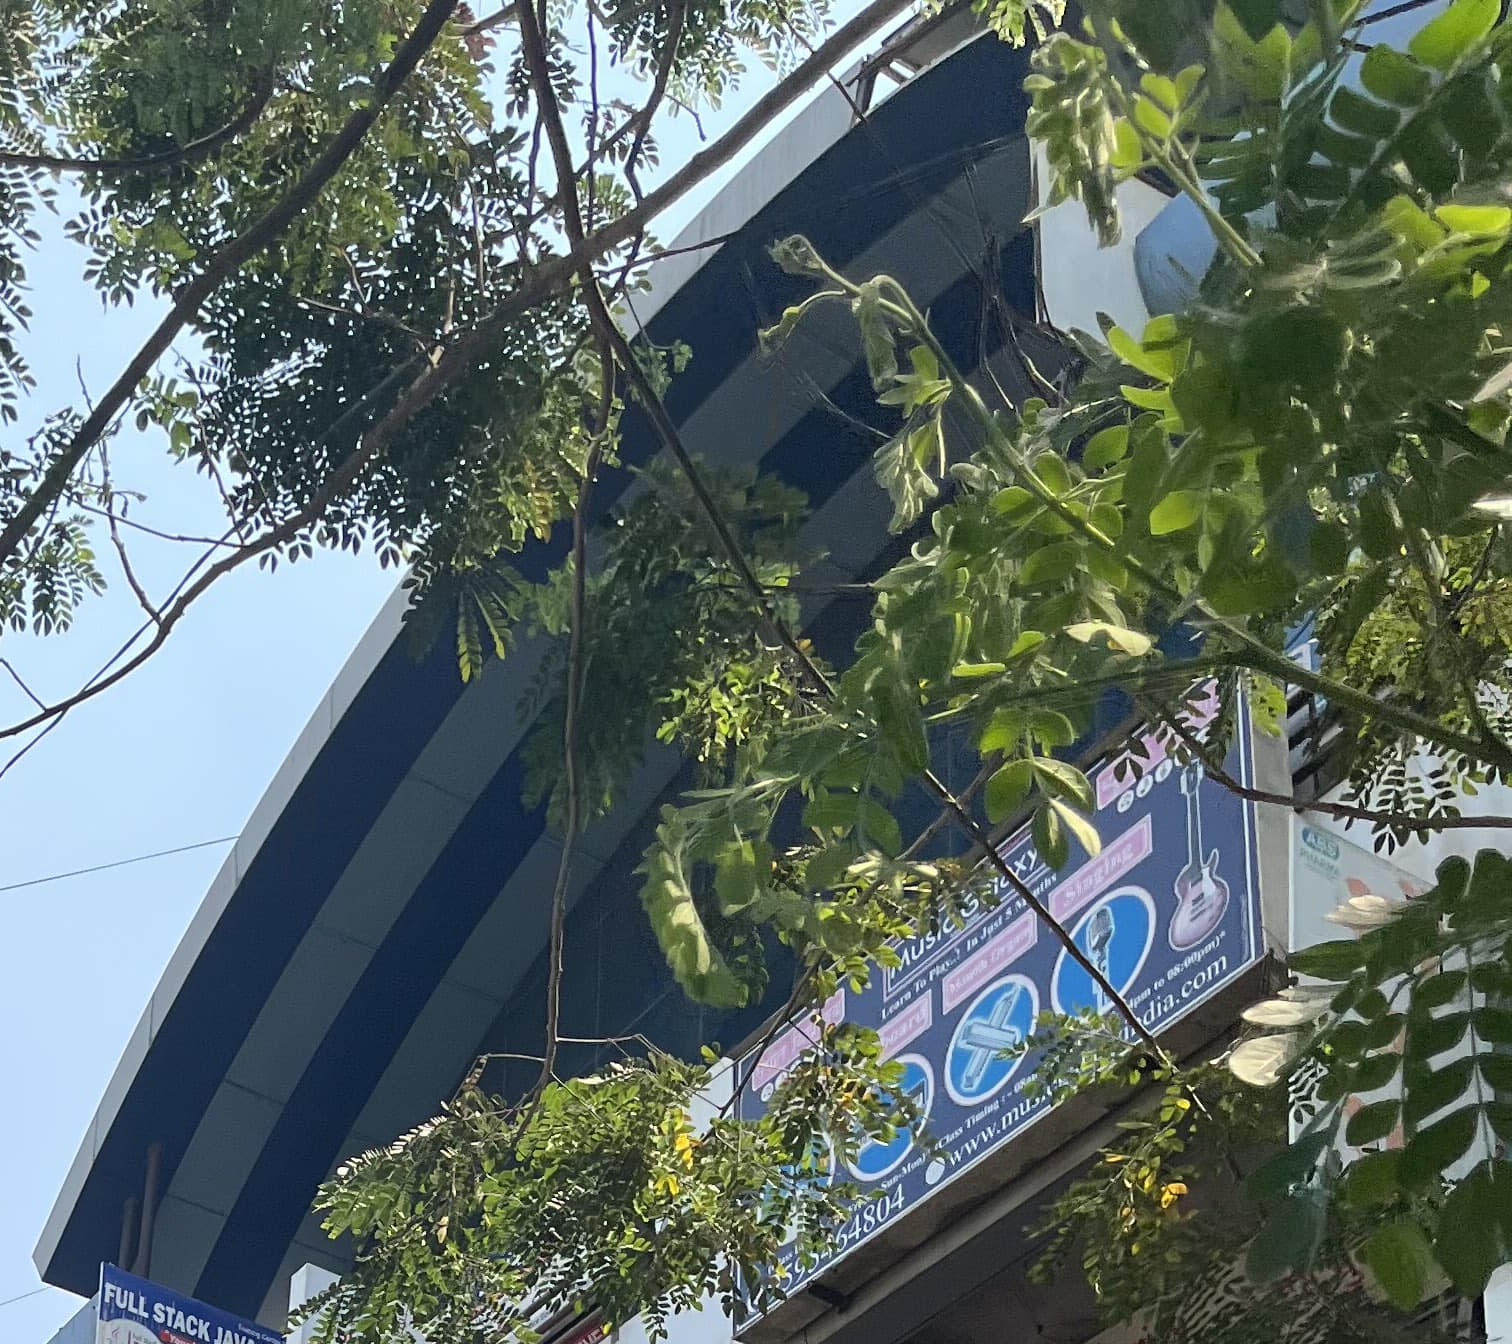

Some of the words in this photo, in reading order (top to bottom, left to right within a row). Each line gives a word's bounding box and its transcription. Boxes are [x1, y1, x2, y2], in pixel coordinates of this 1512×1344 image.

[881, 992, 913, 1021] Learn
[104, 1282, 149, 1319] FULL
[153, 1302, 210, 1342] STACK
